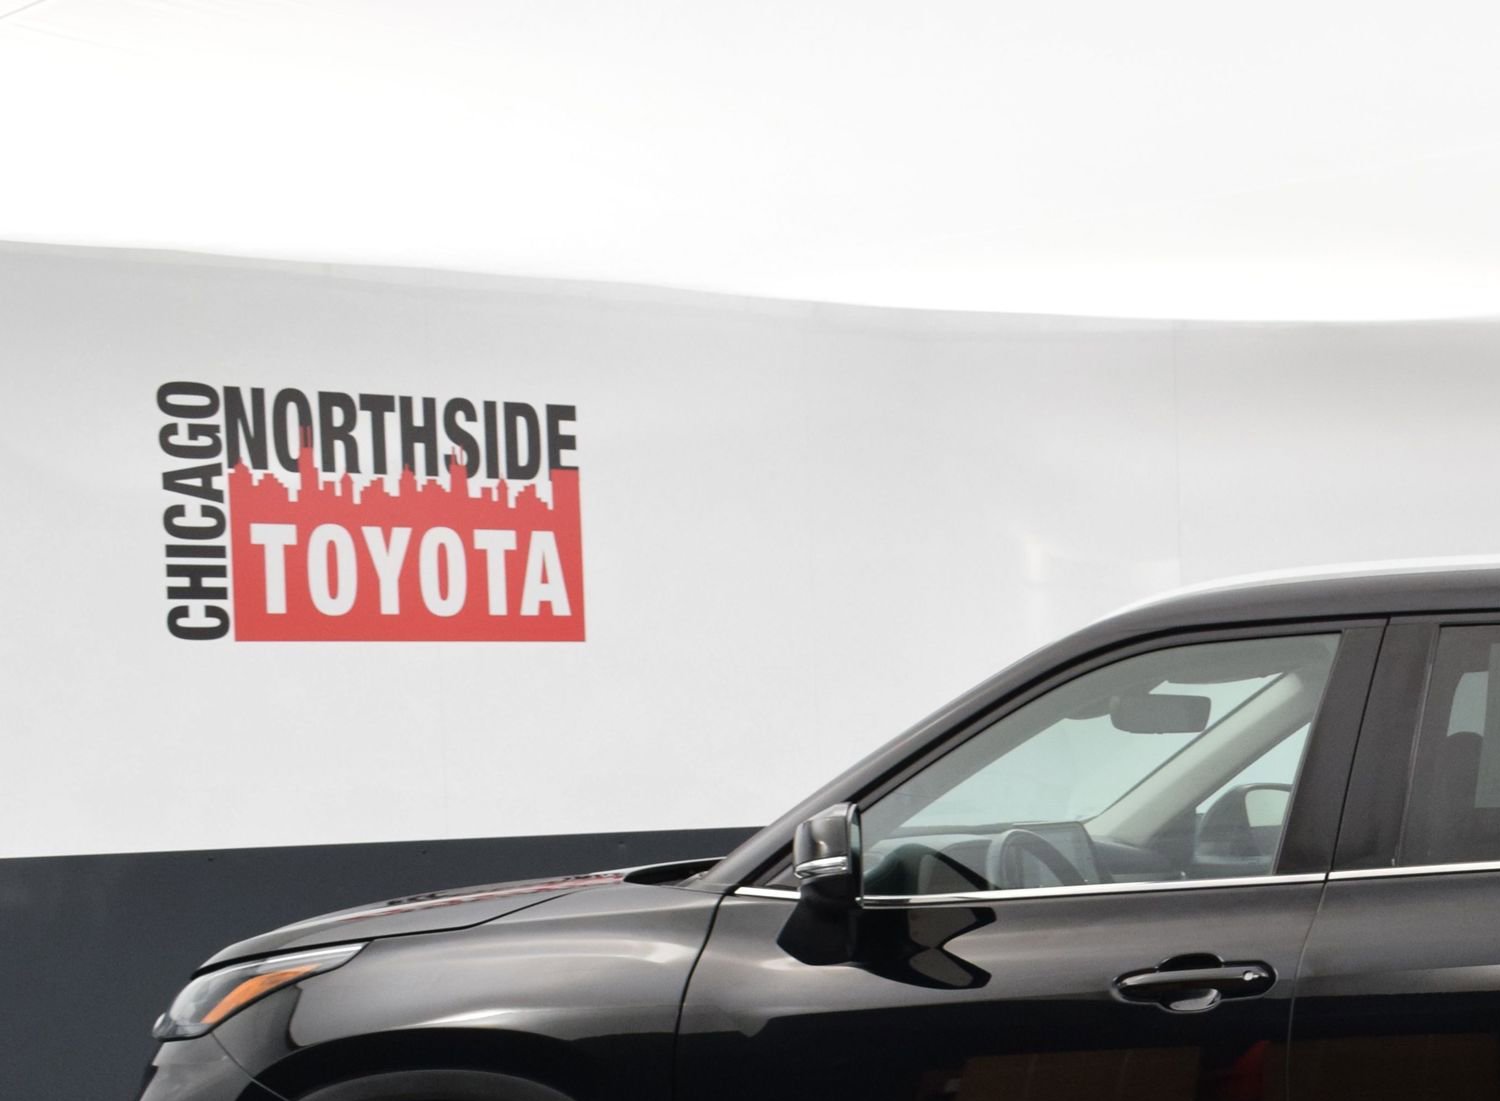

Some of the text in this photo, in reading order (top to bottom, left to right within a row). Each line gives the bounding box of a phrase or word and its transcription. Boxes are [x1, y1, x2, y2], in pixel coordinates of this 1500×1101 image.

[223, 386, 579, 480] NORTHSIDE
[156, 381, 230, 641] CHICAGO
[250, 523, 572, 617] TOYOTA
